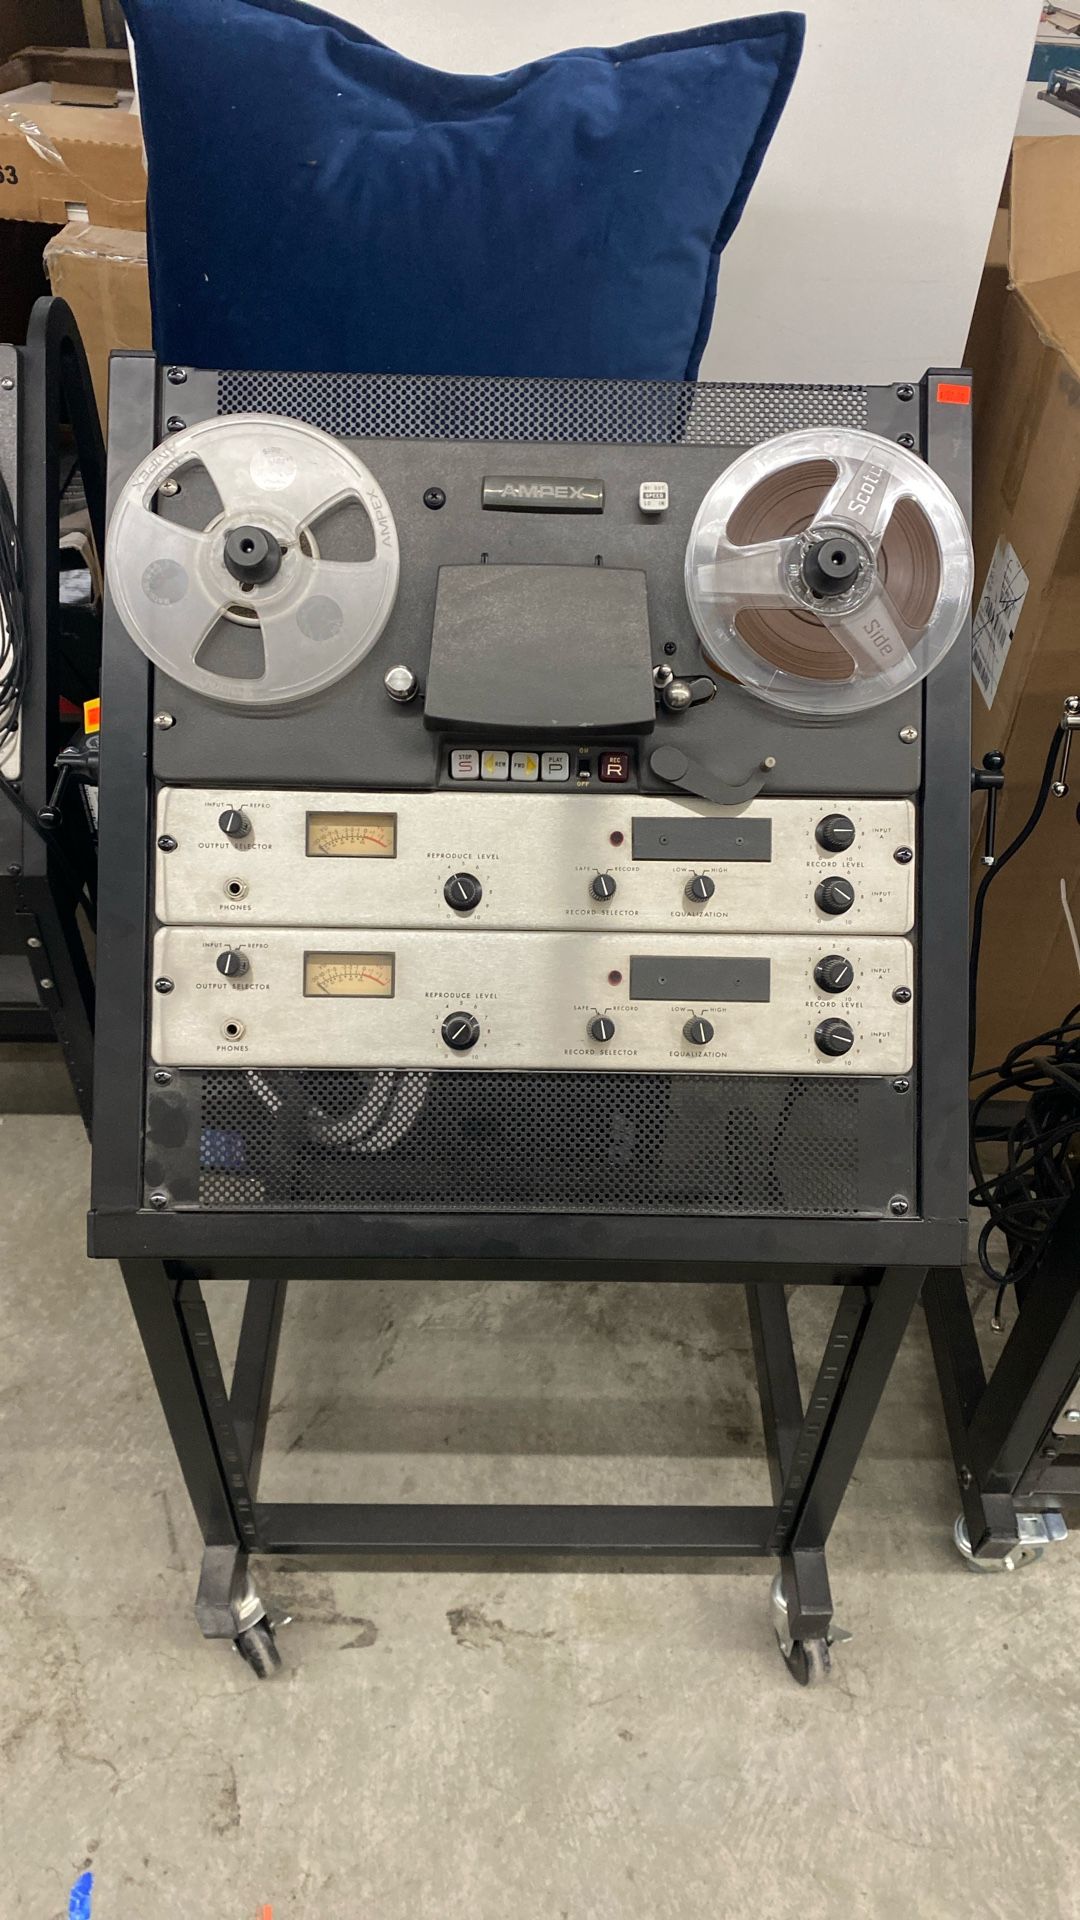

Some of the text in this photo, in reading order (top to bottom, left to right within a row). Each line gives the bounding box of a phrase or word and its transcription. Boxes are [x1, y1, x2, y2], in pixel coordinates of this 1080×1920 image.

[500, 484, 585, 500] AMPEX
[366, 489, 392, 548] AMPEX
[864, 618, 893, 656] Side
[607, 764, 622, 776] R
